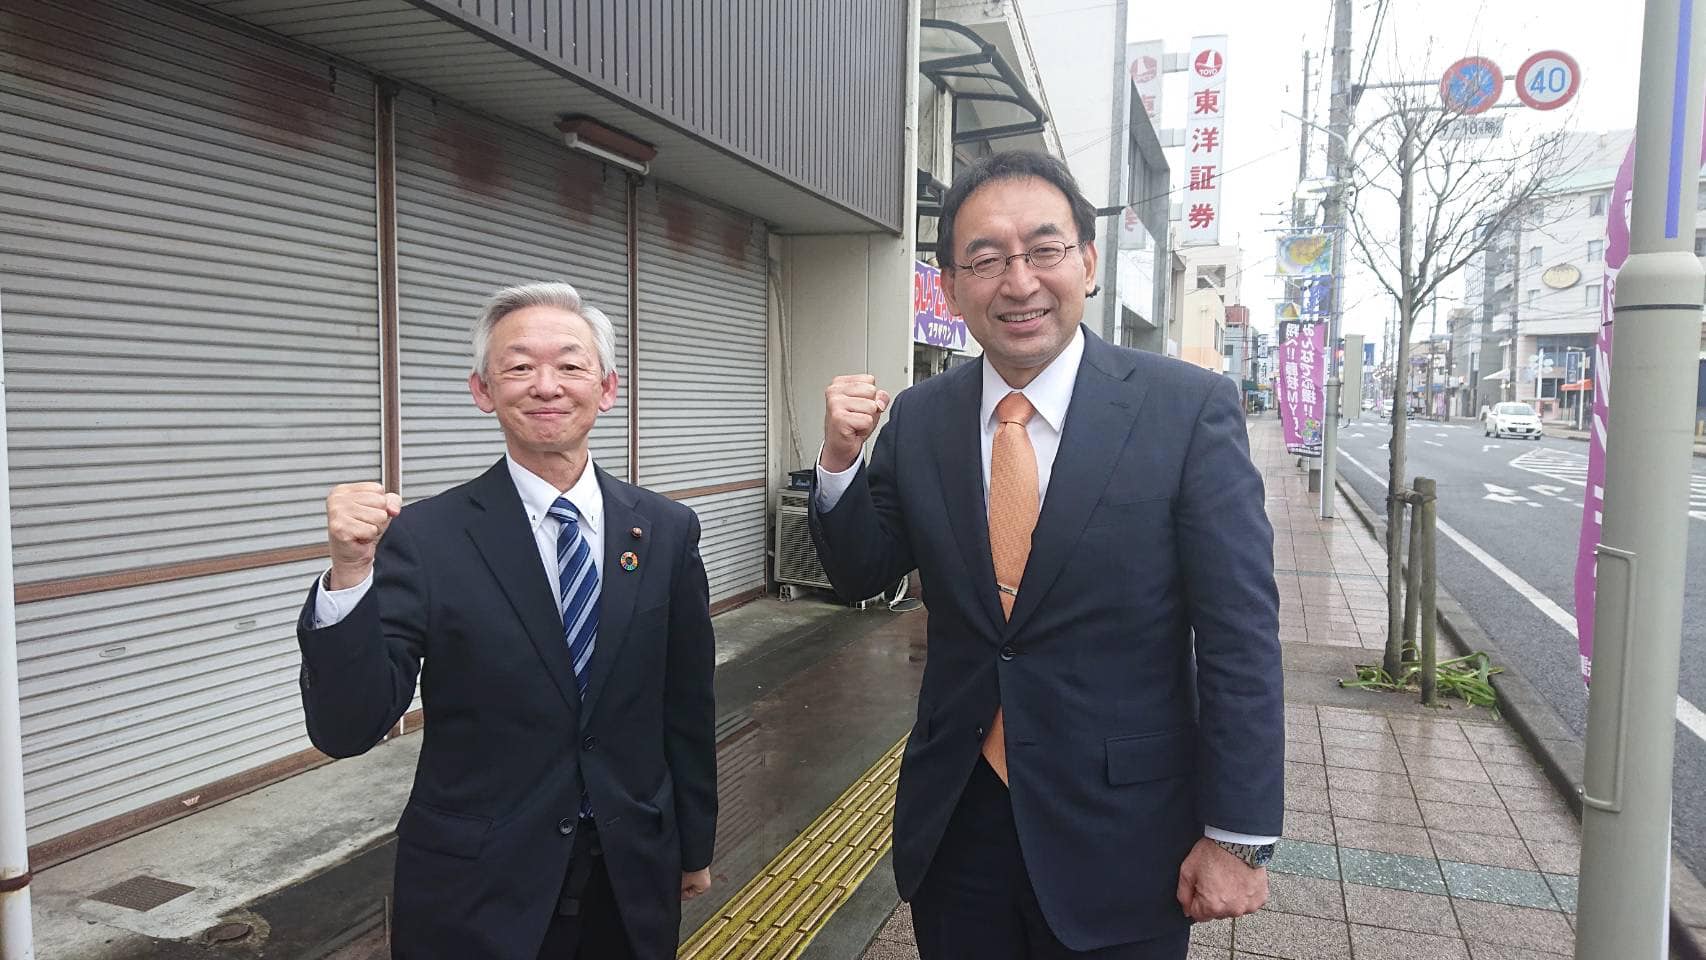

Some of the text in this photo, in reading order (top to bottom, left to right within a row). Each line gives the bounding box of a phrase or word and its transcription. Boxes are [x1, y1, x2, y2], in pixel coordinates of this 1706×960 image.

[1198, 68, 1218, 76] TOYO
[1530, 67, 1566, 95] 40
[1189, 88, 1220, 229] 東洋証券
